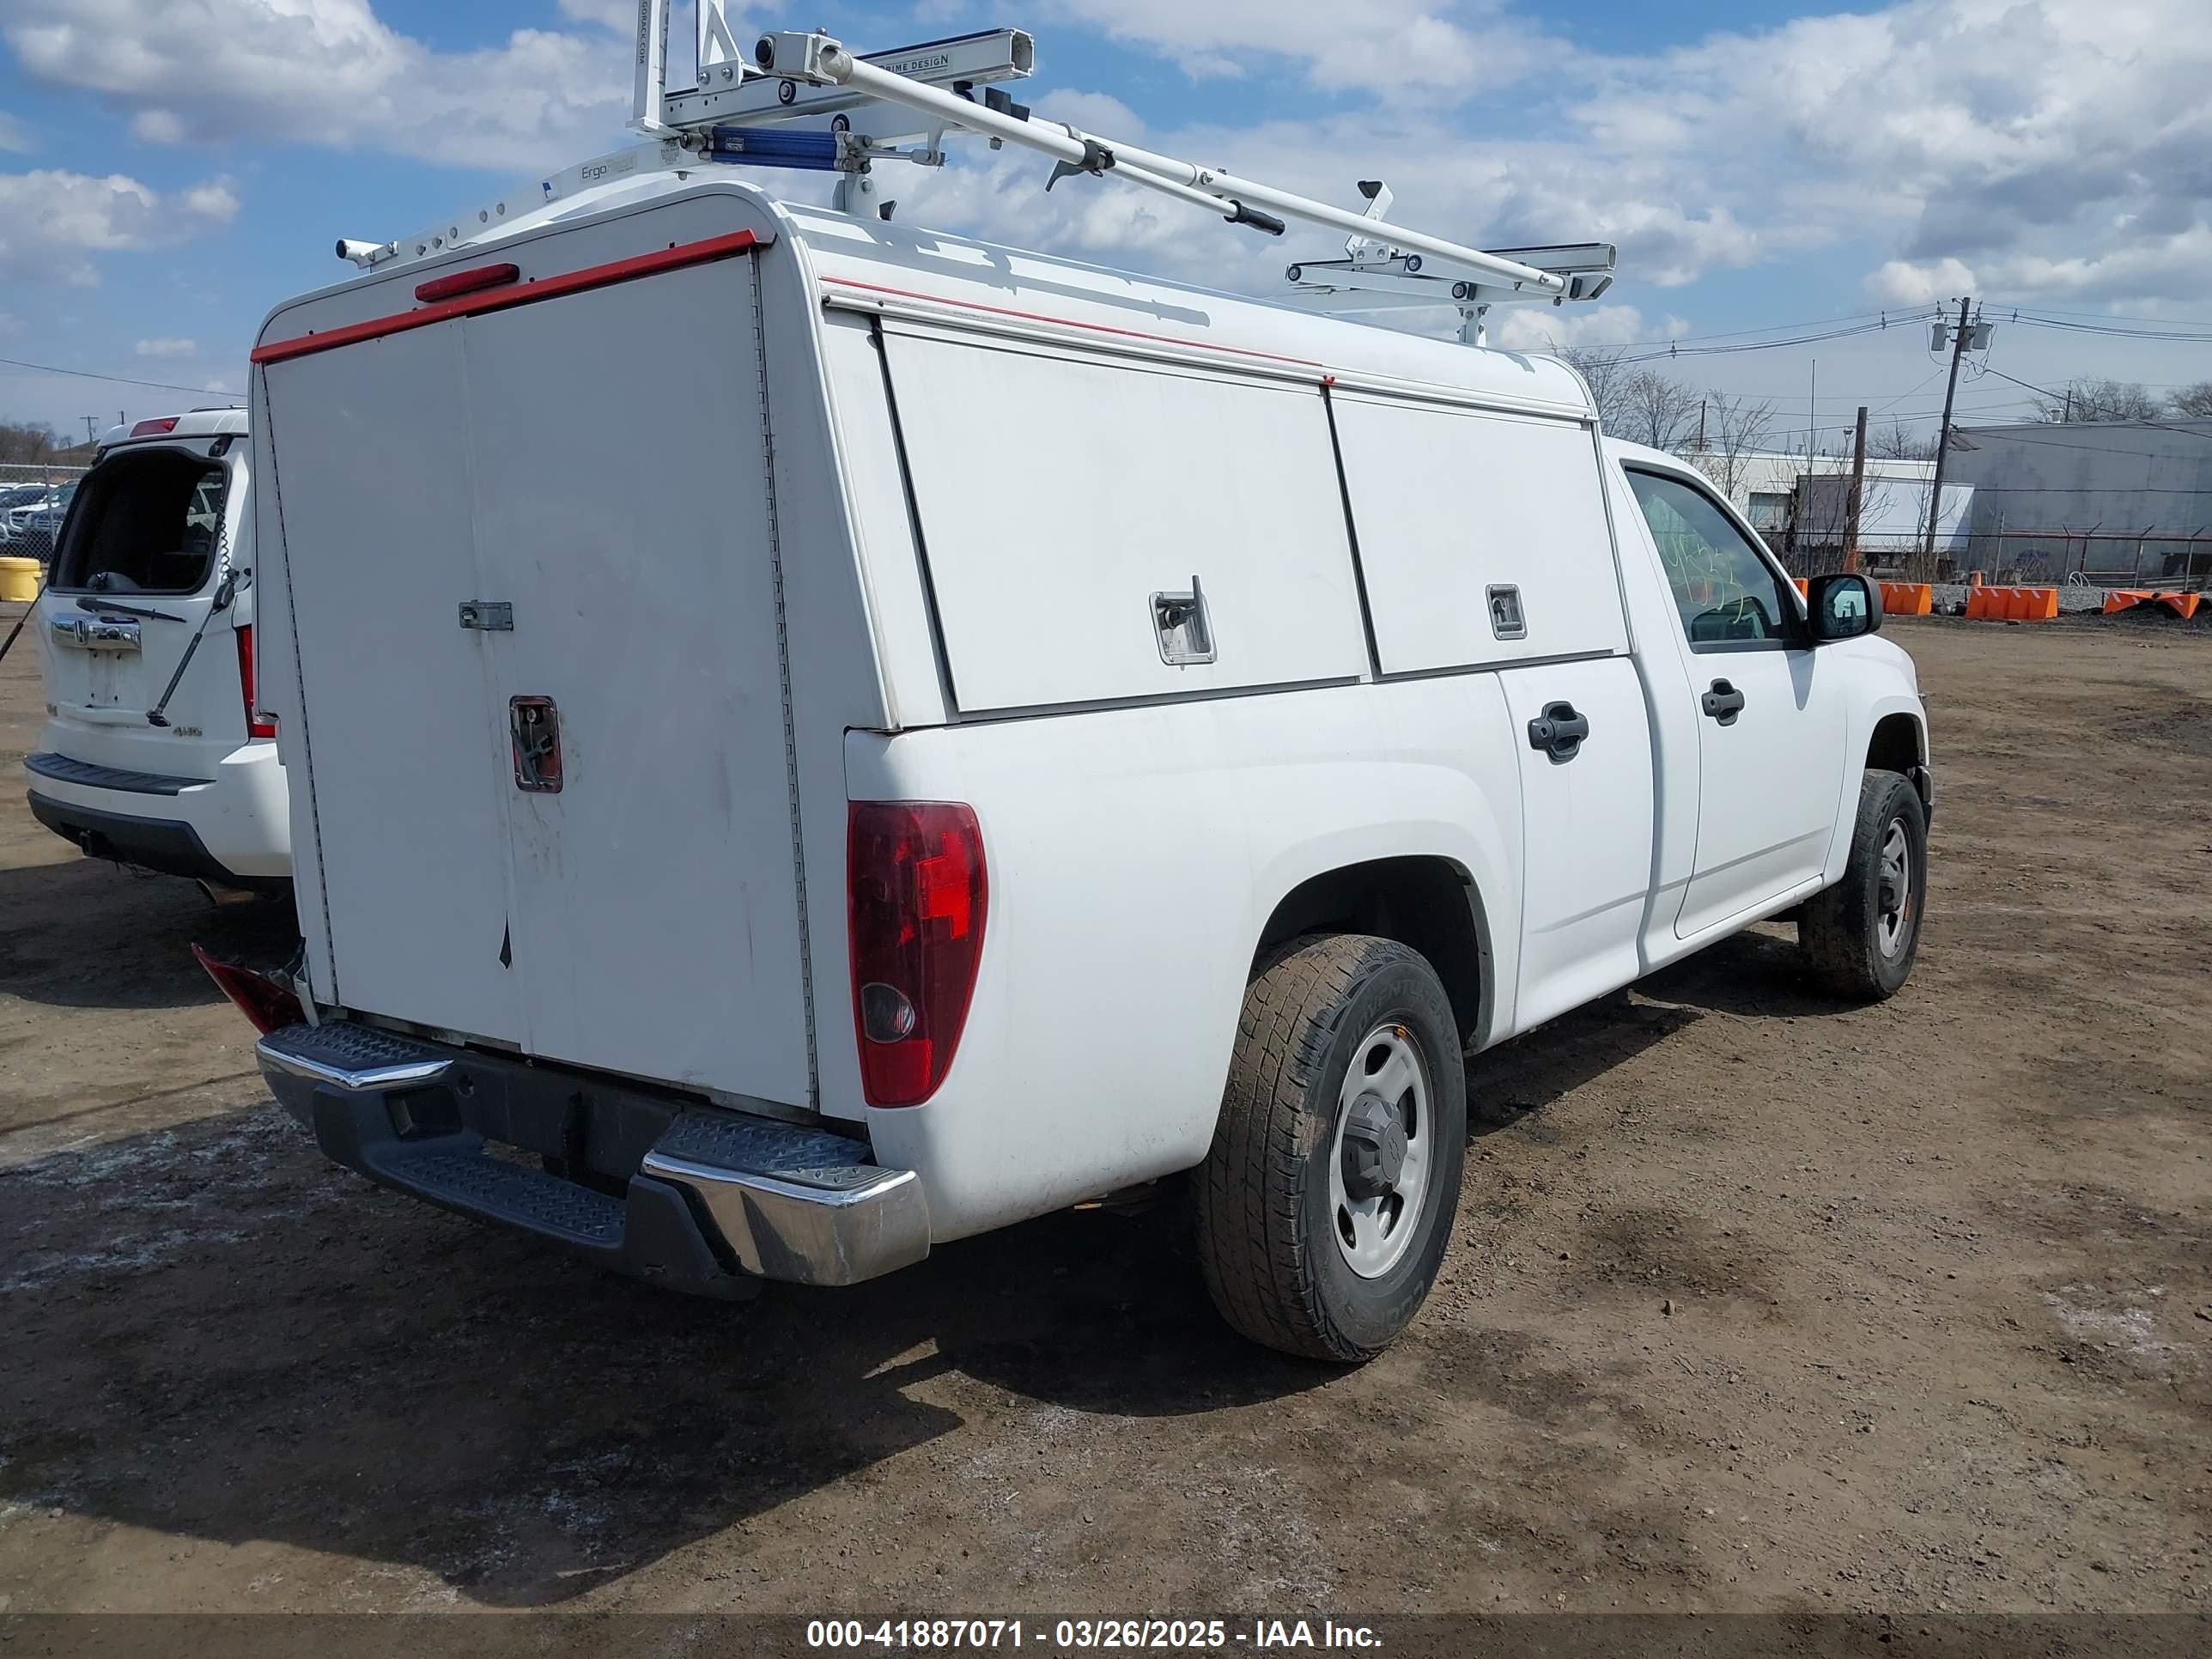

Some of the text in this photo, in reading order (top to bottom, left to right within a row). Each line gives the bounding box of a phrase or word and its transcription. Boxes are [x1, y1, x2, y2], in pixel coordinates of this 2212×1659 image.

[639, 0, 647, 64] GORACK.COM
[911, 54, 949, 70] DESIGN
[581, 165, 608, 179] Ergo
